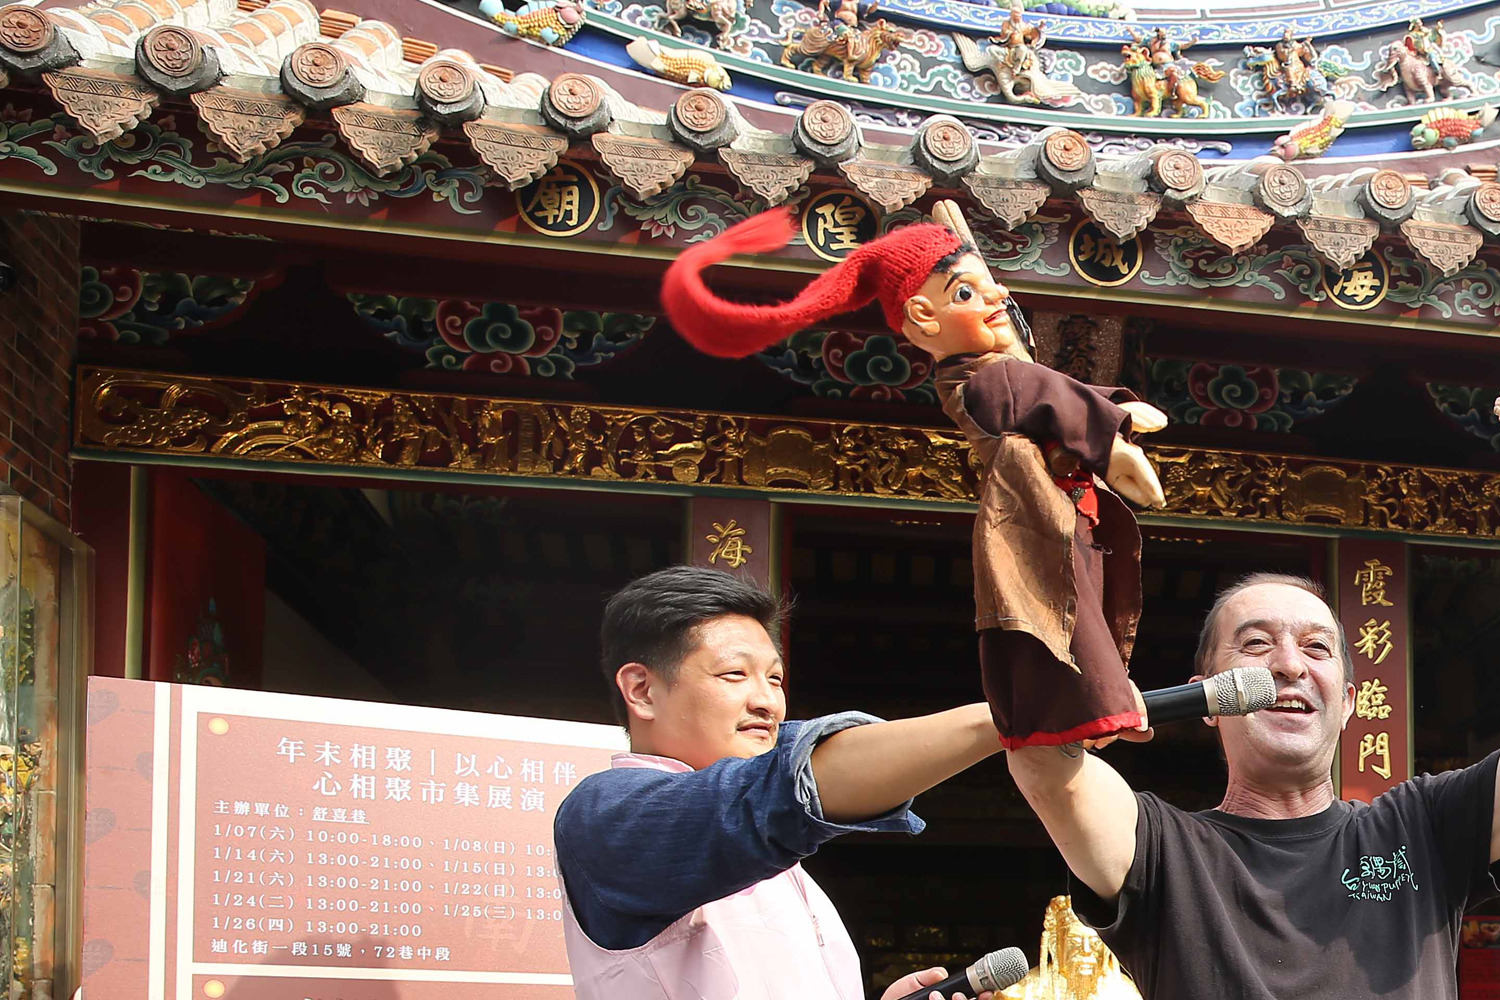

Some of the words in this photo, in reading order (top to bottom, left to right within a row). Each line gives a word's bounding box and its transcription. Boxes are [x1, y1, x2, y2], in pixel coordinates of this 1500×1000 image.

[526, 167, 580, 226] 廟
[816, 203, 860, 249] 隍
[1079, 233, 1130, 275] 城
[707, 519, 752, 569] 海
[1352, 558, 1394, 780] 霞彩臨門
[312, 772, 546, 812] 心相聚市集展演
[306, 921, 422, 937] 13:00-21:00
